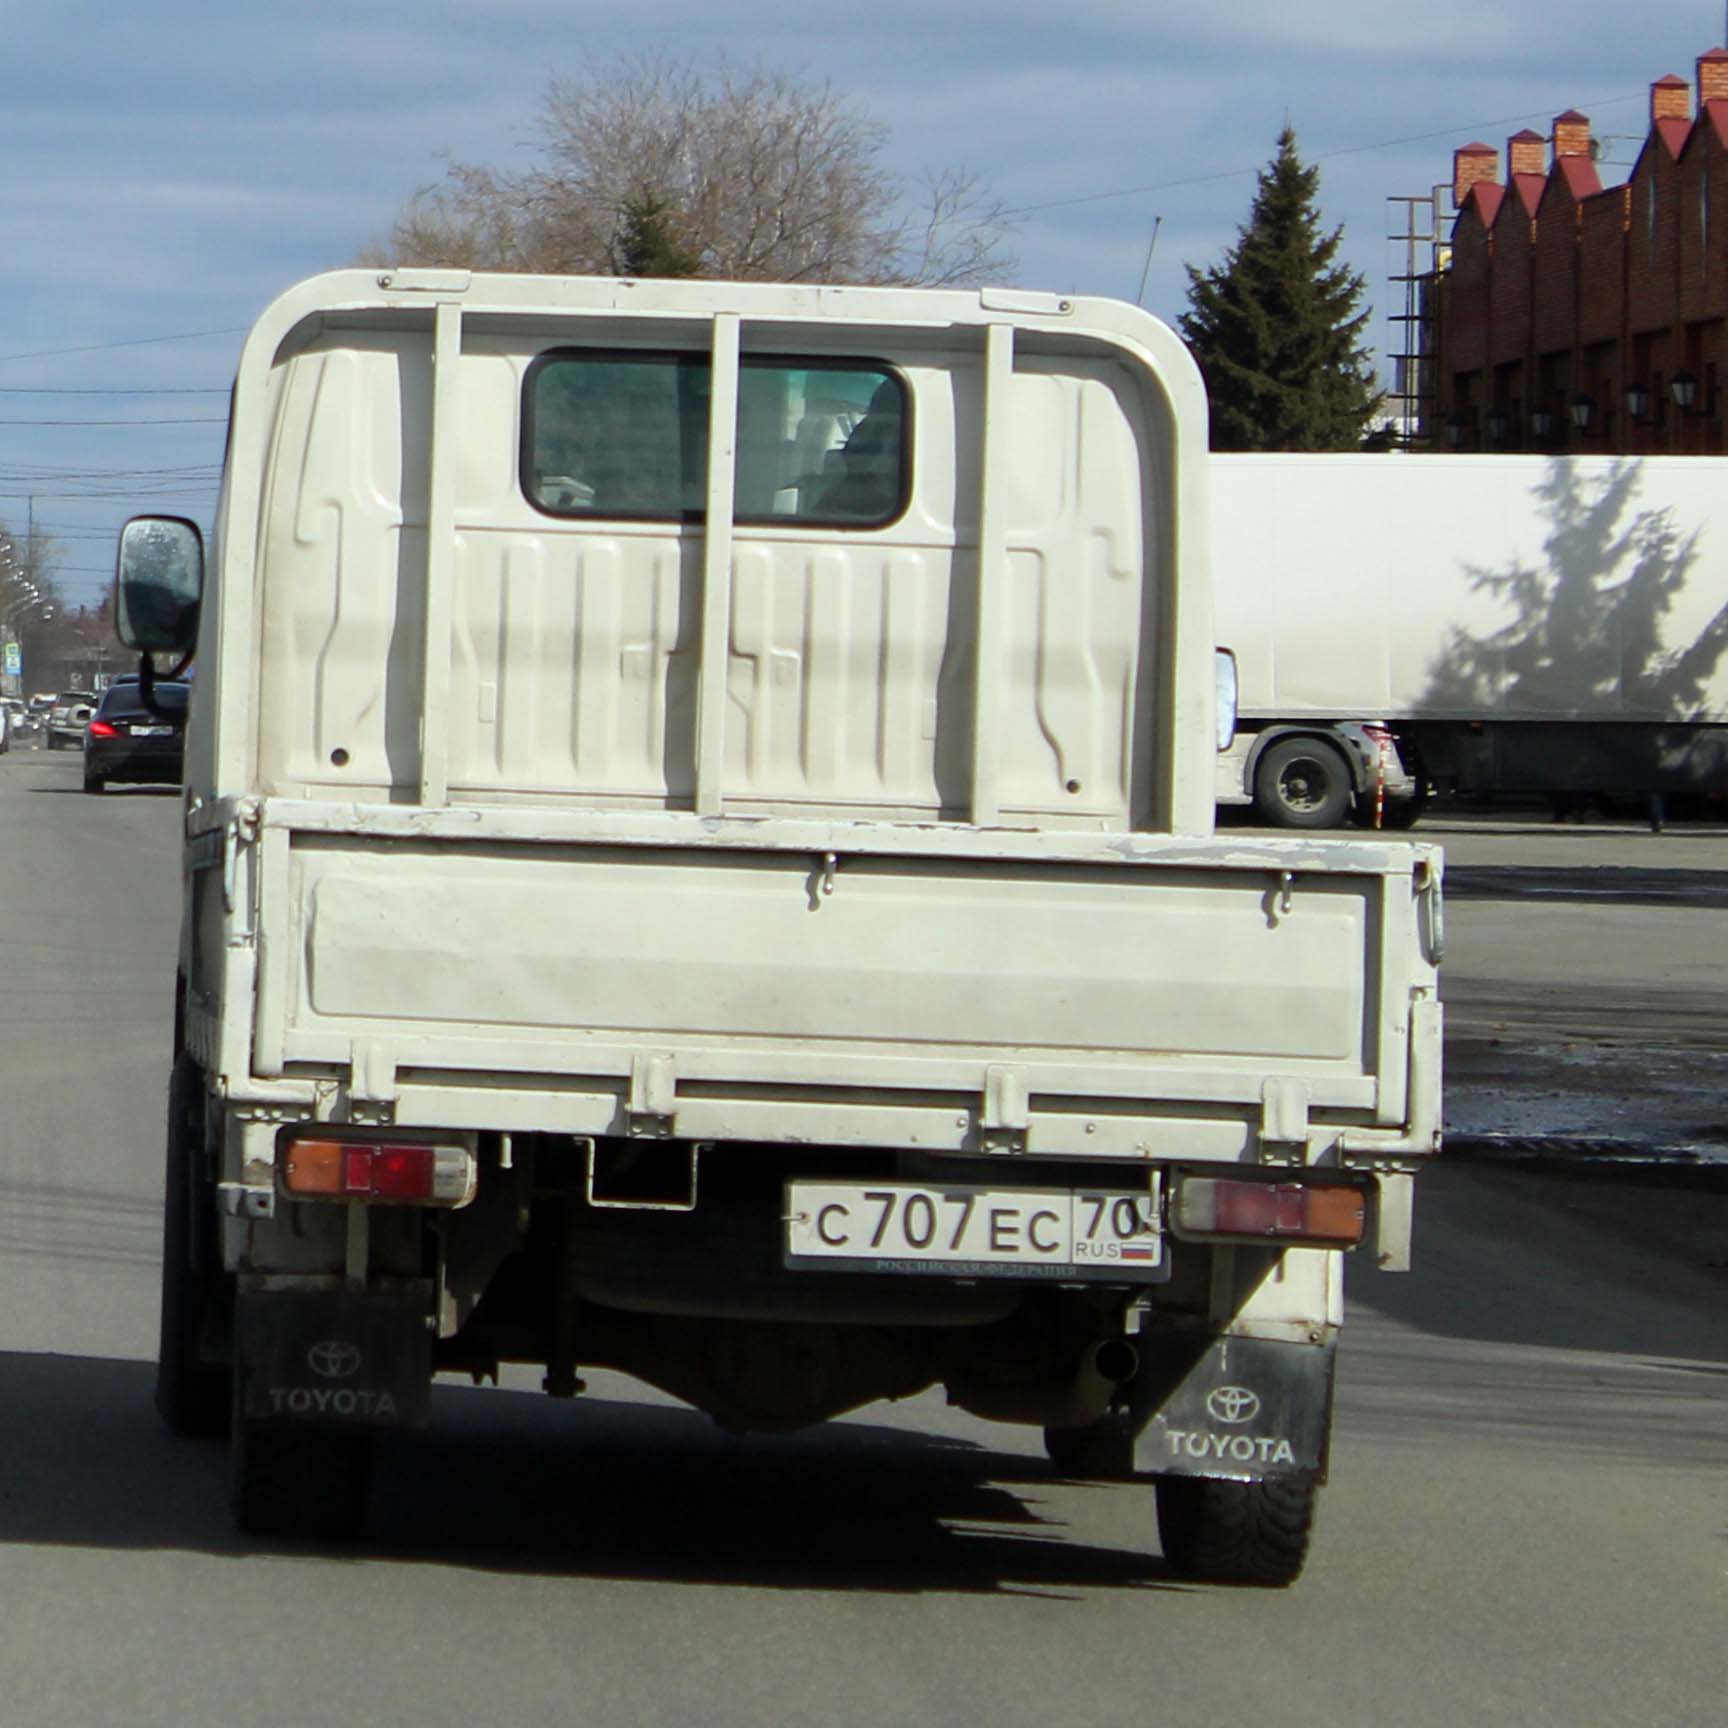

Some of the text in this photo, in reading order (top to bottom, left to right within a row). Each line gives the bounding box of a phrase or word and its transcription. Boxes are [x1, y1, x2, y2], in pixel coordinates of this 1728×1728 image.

[1080, 1196, 1141, 1240] 70
[1075, 1242, 1119, 1258] RUS
[268, 1387, 397, 1417] TOYOTA
[1164, 1430, 1296, 1465] TOYOTA
